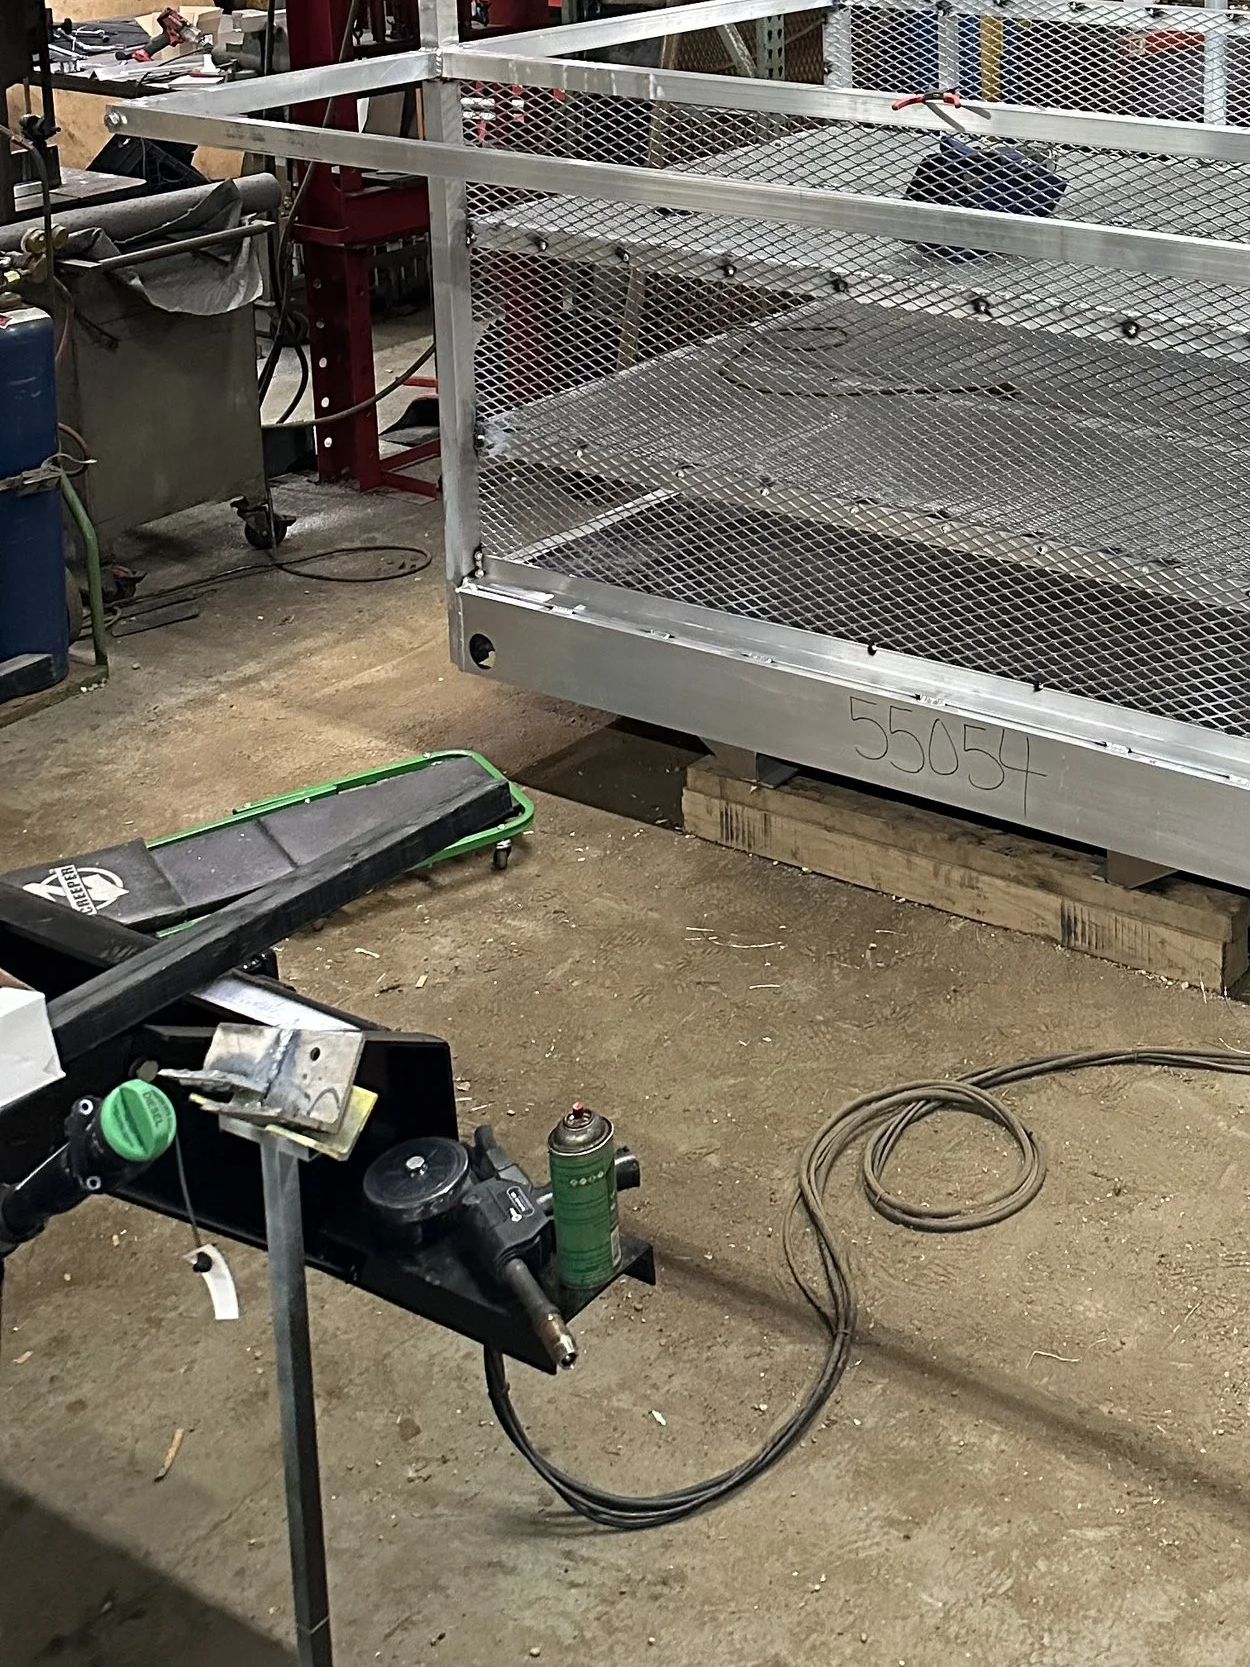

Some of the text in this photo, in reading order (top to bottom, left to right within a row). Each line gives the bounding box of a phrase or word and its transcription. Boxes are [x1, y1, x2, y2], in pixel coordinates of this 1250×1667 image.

[850, 696, 1048, 818] 55054
[60, 866, 93, 915] CREEPER
[143, 1091, 163, 1127] DIESEL
